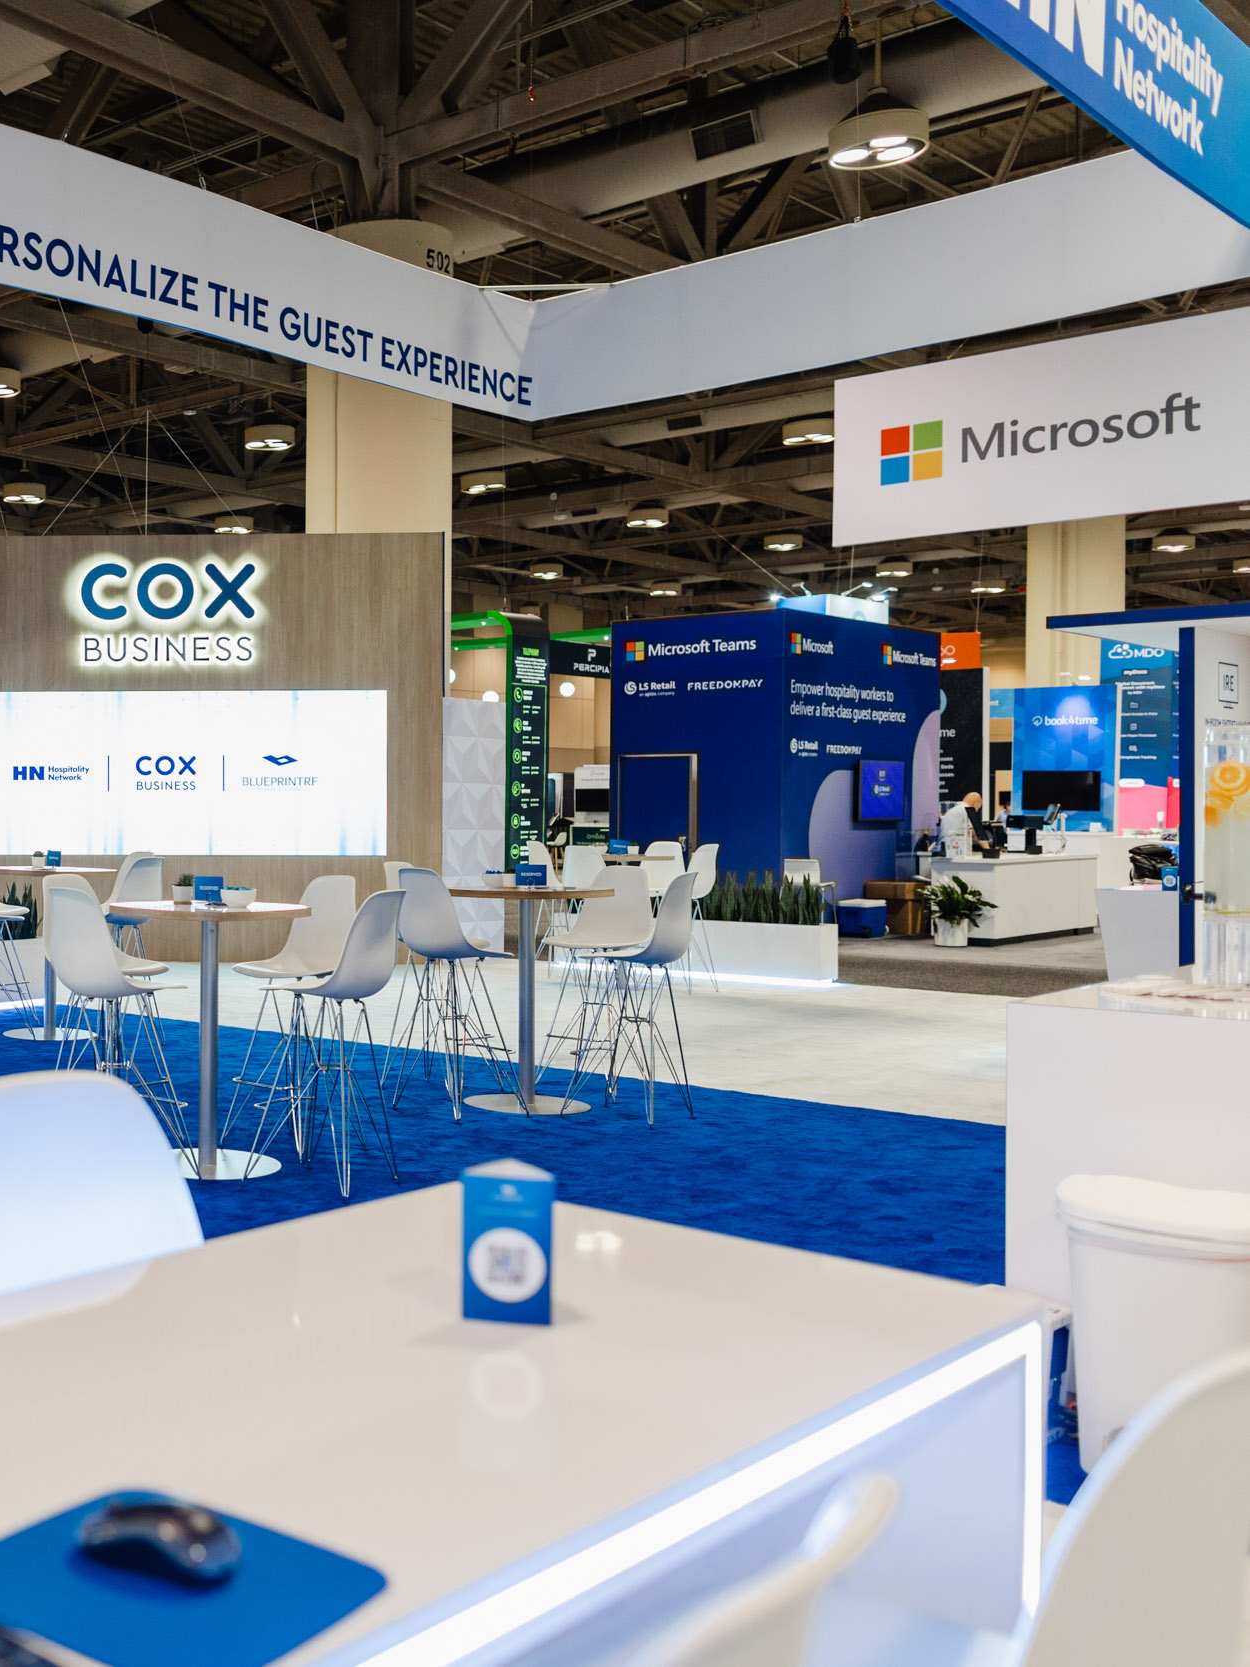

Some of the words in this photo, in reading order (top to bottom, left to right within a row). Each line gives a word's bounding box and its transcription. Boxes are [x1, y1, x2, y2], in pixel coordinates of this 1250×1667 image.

[1115, 0, 1224, 117] Hospitality
[1113, 36, 1204, 155] Network
[425, 248, 451, 274] 502
[208, 281, 269, 333] THE
[279, 306, 374, 362] GUEST
[381, 336, 533, 406] EXPERIENCE
[961, 392, 1201, 463] Microsoft
[81, 563, 255, 620] COX
[83, 636, 253, 662] BUSINESS
[648, 639, 710, 657] Microsoft
[712, 638, 757, 653] Teams
[802, 637, 834, 655] Microsoft
[1133, 648, 1165, 658] MDO
[892, 650, 919, 665] Microsoft
[919, 653, 937, 667] Teams
[573, 662, 610, 674] PERCIPIA
[638, 682, 649, 691] LS
[650, 680, 676, 690] Retail
[790, 679, 825, 698] Empower
[825, 681, 861, 703] hospitality
[860, 686, 886, 702] workers
[886, 689, 895, 703] to
[1222, 674, 1235, 692] IRE
[790, 700, 815, 716] deliver
[815, 705, 821, 717] a
[821, 702, 853, 719] first-class
[853, 707, 872, 723] guest
[871, 708, 907, 724] experience
[1044, 714, 1099, 726] book4time
[798, 740, 805, 750] LS
[804, 741, 819, 751] Retail
[13, 766, 45, 781] HN
[48, 766, 90, 774] Hospitality
[135, 755, 197, 776] COX
[48, 773, 82, 781] Network
[136, 781, 196, 791] BUSINESS
[242, 776, 318, 787] BLUEPRINTRF
